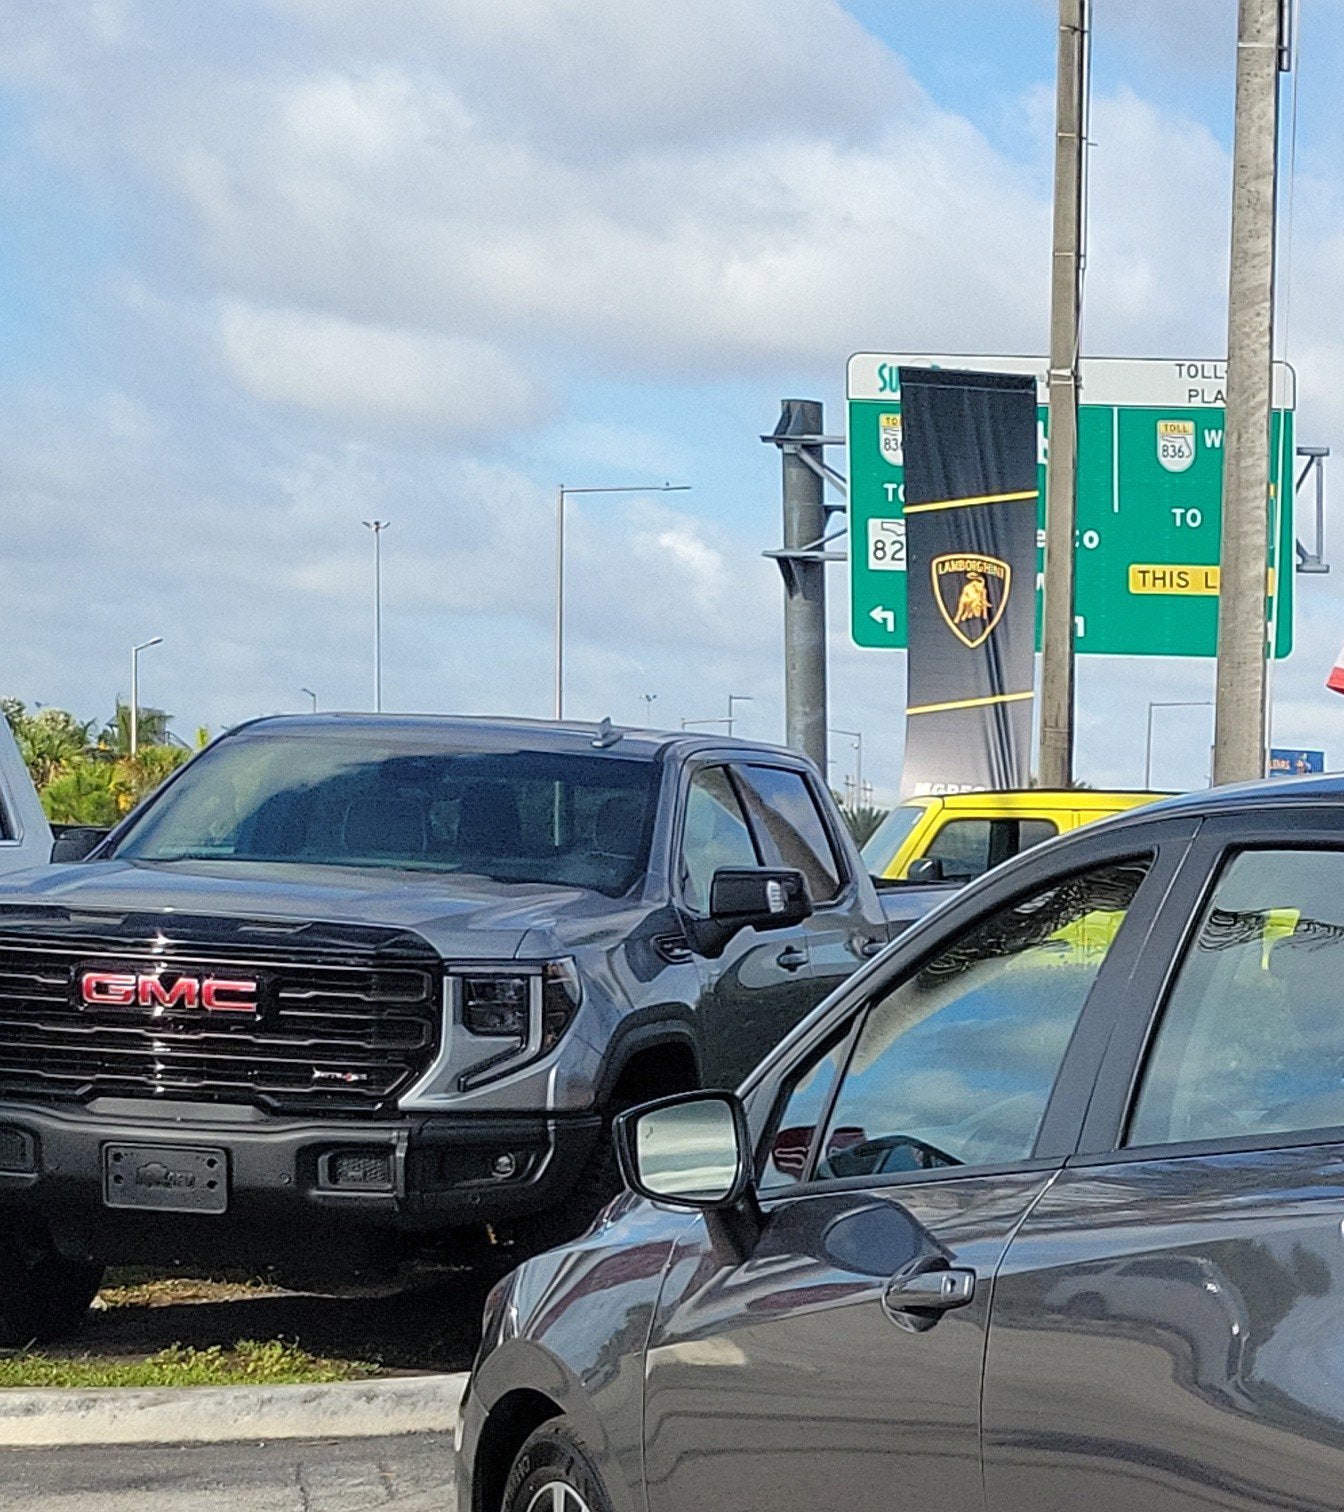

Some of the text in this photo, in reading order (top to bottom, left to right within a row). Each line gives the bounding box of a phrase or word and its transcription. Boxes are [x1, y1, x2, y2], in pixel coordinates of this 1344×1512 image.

[1187, 388, 1227, 404] PLA
[1163, 423, 1189, 434] TOLL
[883, 438, 903, 451] 83
[1161, 444, 1185, 459] 836
[1170, 507, 1202, 528] TO
[872, 540, 905, 562] 82
[1138, 570, 1190, 589] THIS
[81, 972, 258, 1013] GMC
